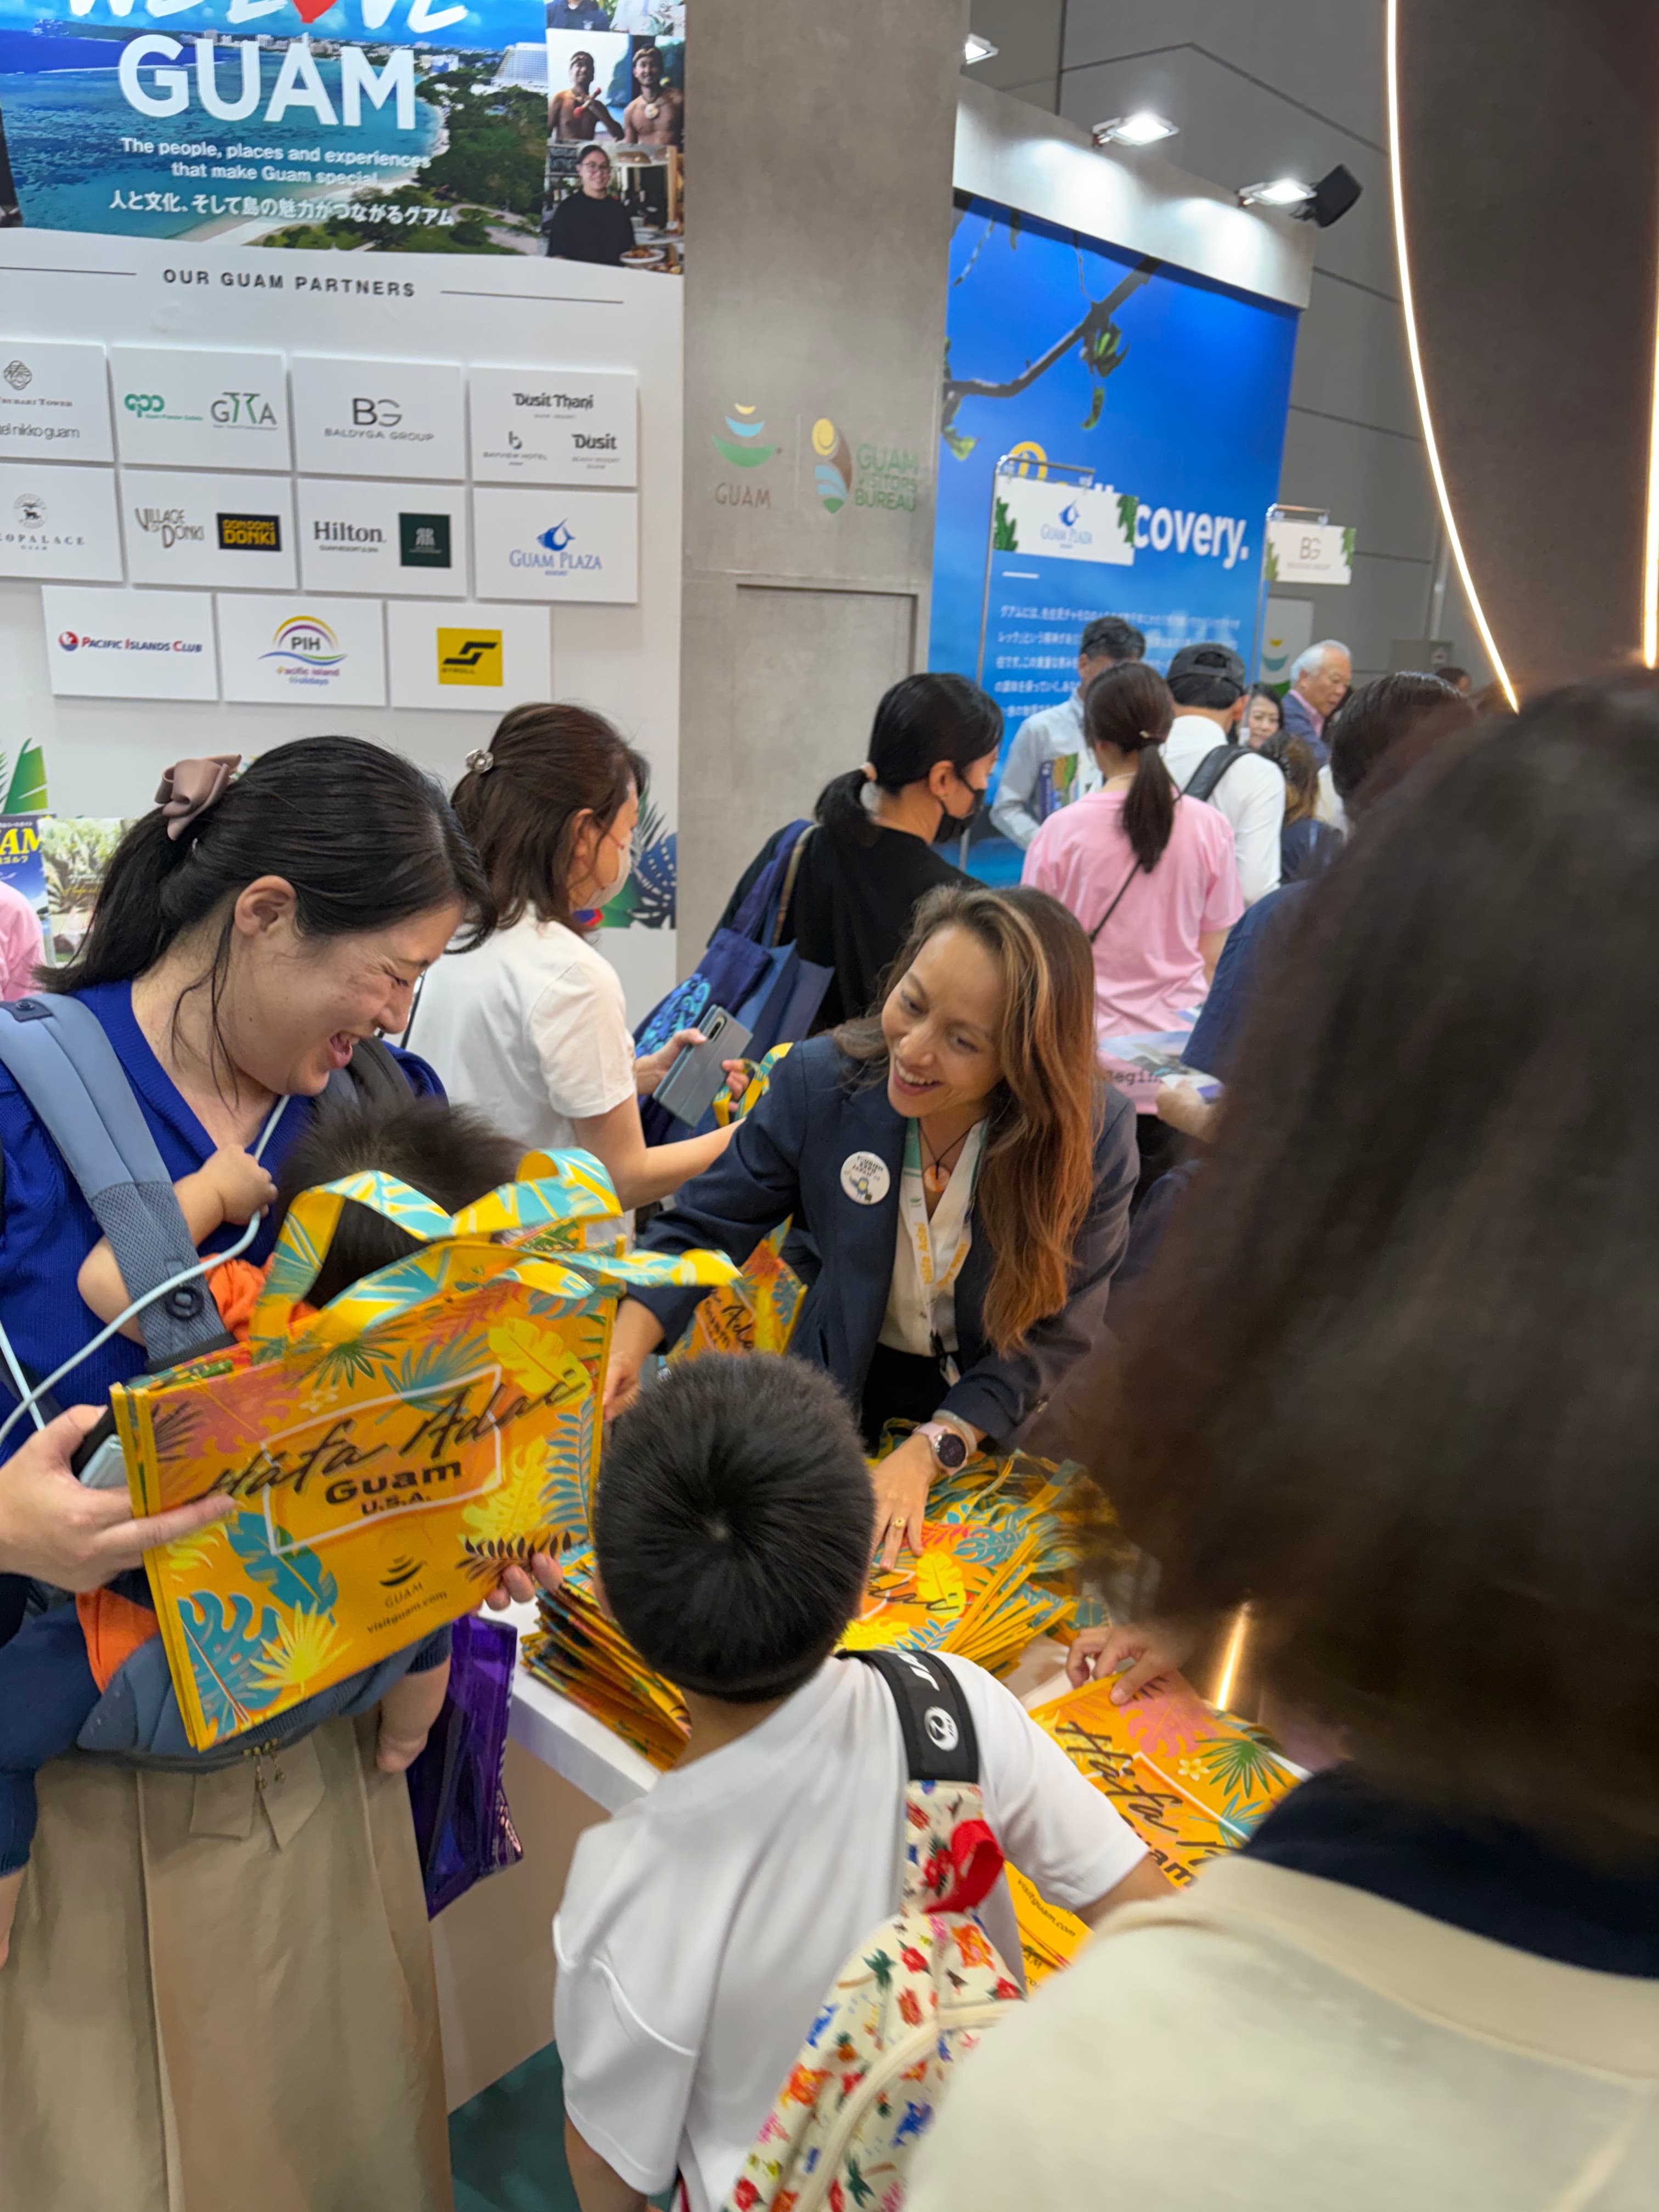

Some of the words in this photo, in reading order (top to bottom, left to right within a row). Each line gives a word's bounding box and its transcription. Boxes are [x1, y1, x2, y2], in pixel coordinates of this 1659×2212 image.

[119, 33, 415, 129] GUAM
[121, 138, 154, 153] The
[159, 142, 222, 159] people,
[226, 144, 284, 160] places
[287, 147, 321, 162] and
[324, 151, 431, 168] experiences
[171, 162, 207, 177] that
[211, 165, 257, 180] make
[261, 166, 312, 182] Guam
[163, 269, 209, 286] OUR
[221, 272, 284, 289] GUAM
[295, 276, 415, 297] PARTNERS
[512, 393, 551, 407] Dusit
[552, 394, 594, 410] Thani
[44, 427, 81, 441] guam
[325, 427, 385, 439] BALDYGA
[390, 431, 434, 442] GROUP
[571, 433, 618, 450] Dusit
[856, 444, 919, 473] GUAM
[858, 475, 917, 492] VISITORS
[714, 482, 771, 510] GUAM
[854, 491, 917, 512] BUREAU
[223, 529, 276, 545] DONKI
[313, 521, 382, 543] Hilton
[1133, 504, 1249, 570] covery.
[509, 550, 555, 567] GUAM
[559, 552, 602, 570] PLAZA
[82, 637, 123, 650] PACIFIC
[126, 639, 170, 651] ISLANDS
[173, 640, 202, 652] CLUB
[291, 636, 321, 651] PIH
[0, 828, 40, 855] AM
[325, 1460, 462, 1505] Guam
[360, 1490, 432, 1515] U.S.A.
[384, 1581, 424, 1608] GUAM
